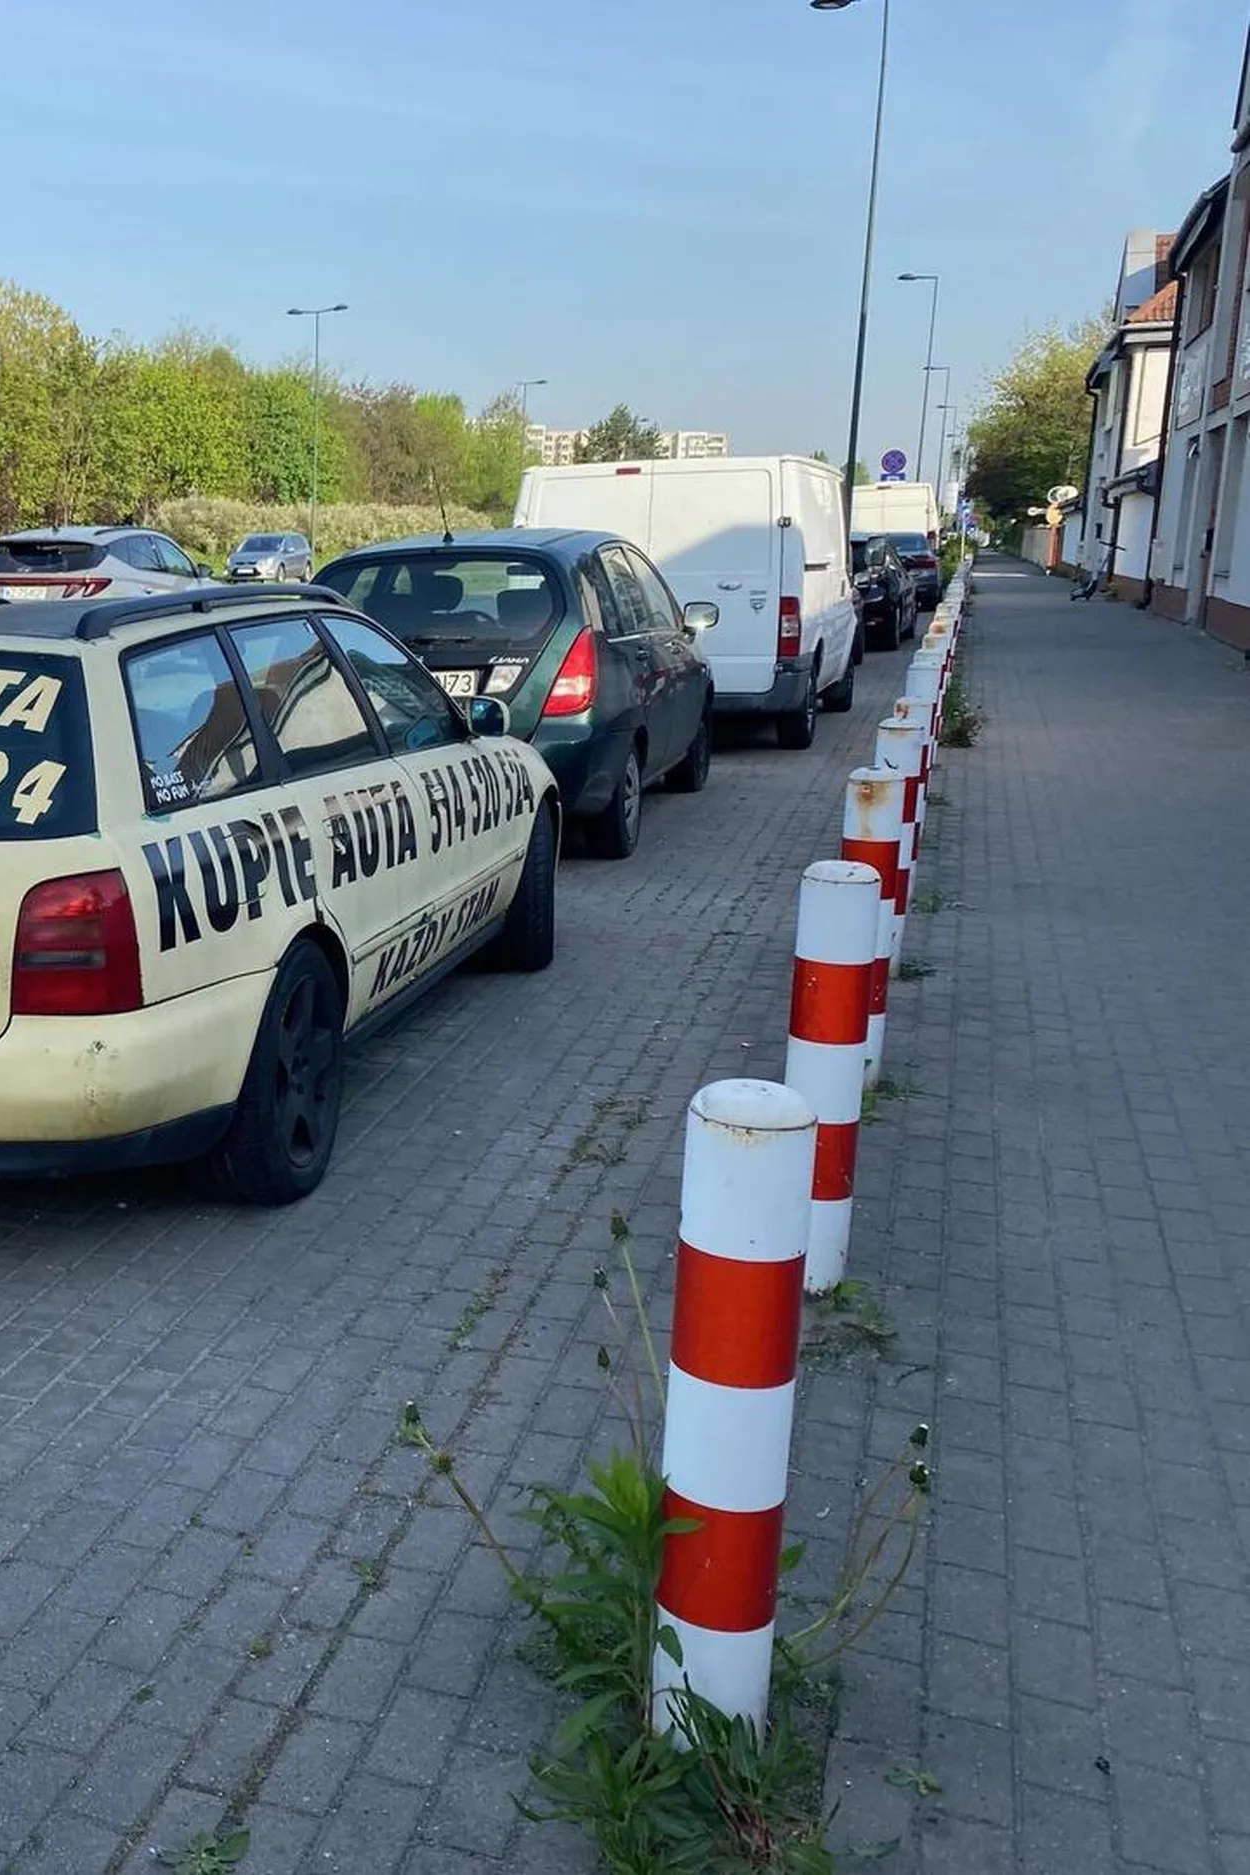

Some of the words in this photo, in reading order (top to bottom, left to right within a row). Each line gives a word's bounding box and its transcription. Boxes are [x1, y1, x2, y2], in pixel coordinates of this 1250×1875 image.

[156, 788, 172, 805] NO
[323, 780, 418, 889] AUTA
[419, 765, 466, 854] 514
[461, 754, 502, 837] 520
[494, 748, 535, 823] 524
[449, 876, 500, 943] STAN
